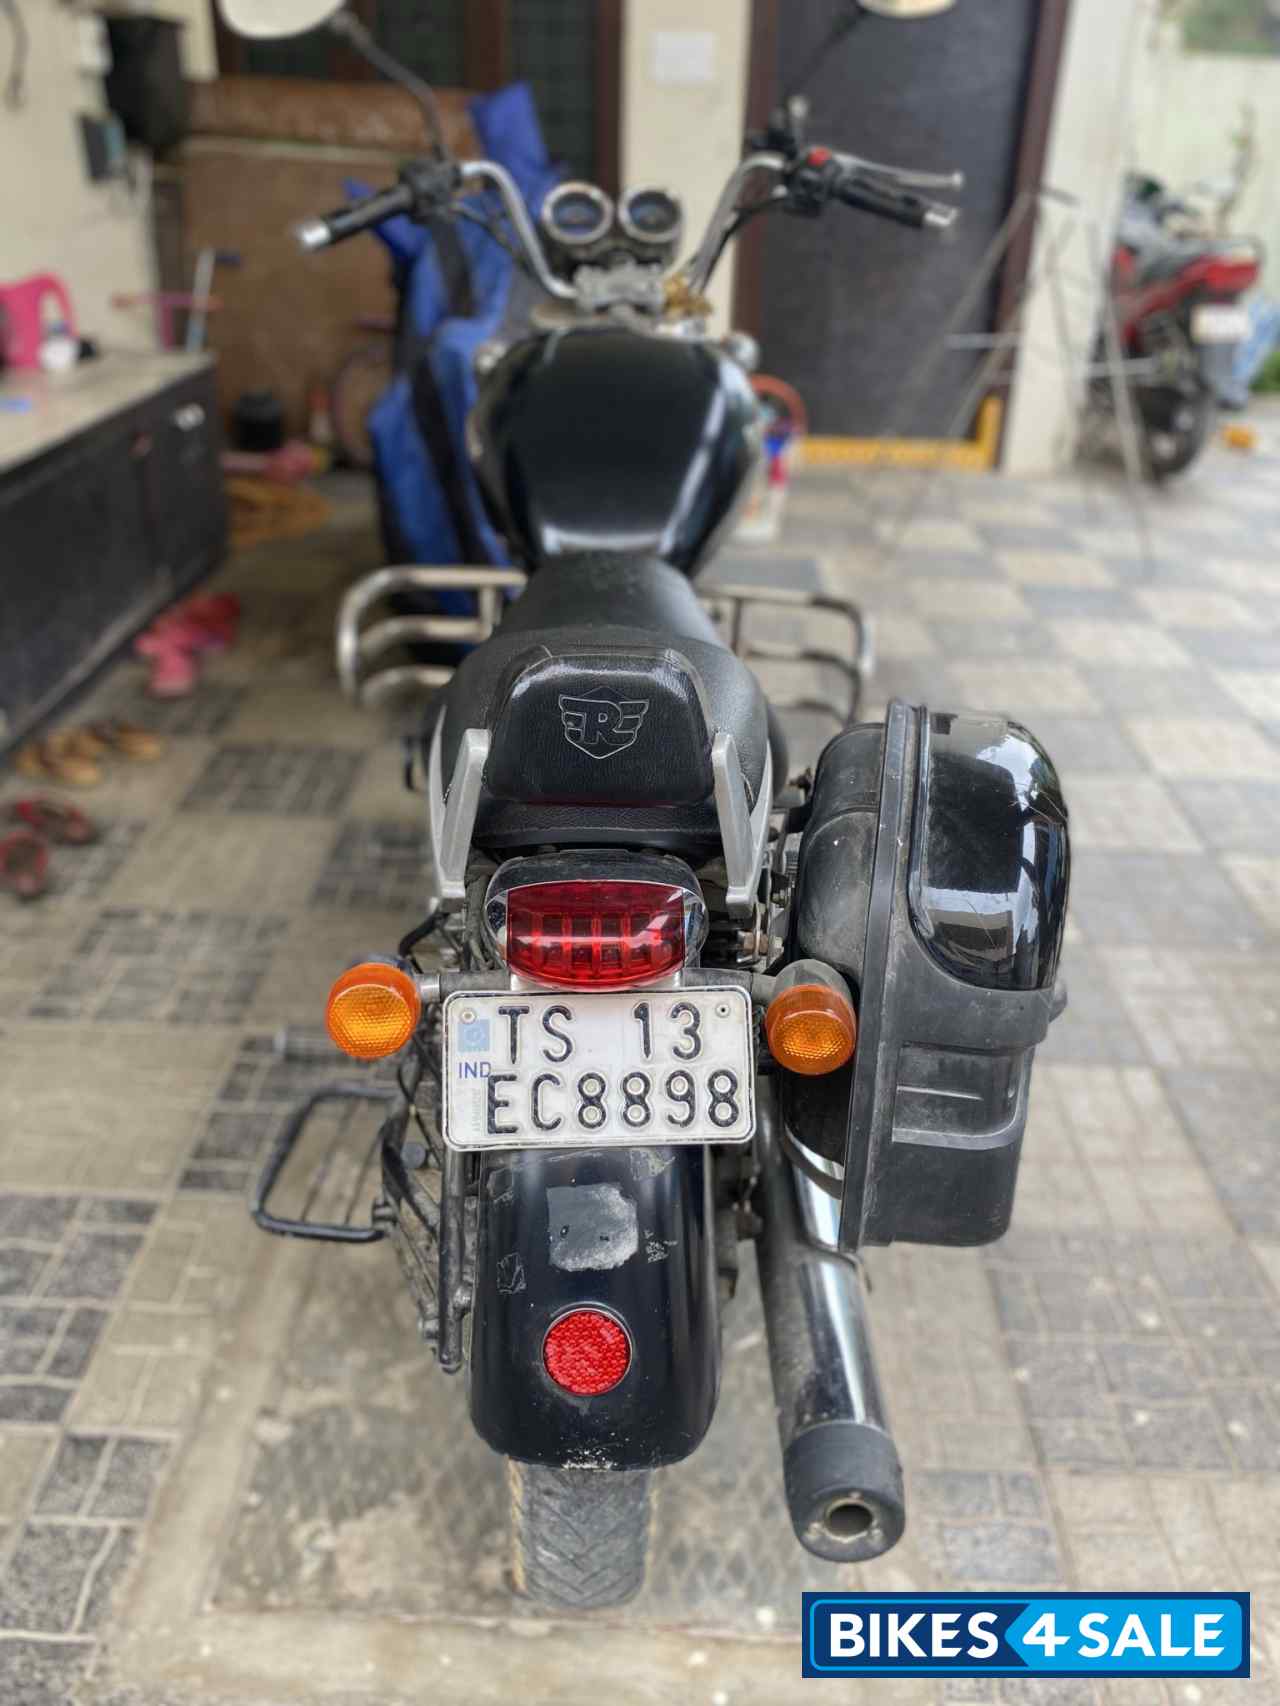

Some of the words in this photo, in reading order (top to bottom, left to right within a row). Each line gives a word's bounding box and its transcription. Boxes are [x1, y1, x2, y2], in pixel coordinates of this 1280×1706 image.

[498, 1004, 573, 1064] TS
[633, 1001, 701, 1061] 13
[458, 1061, 492, 1079] IND
[487, 1069, 740, 1135] EC8898
